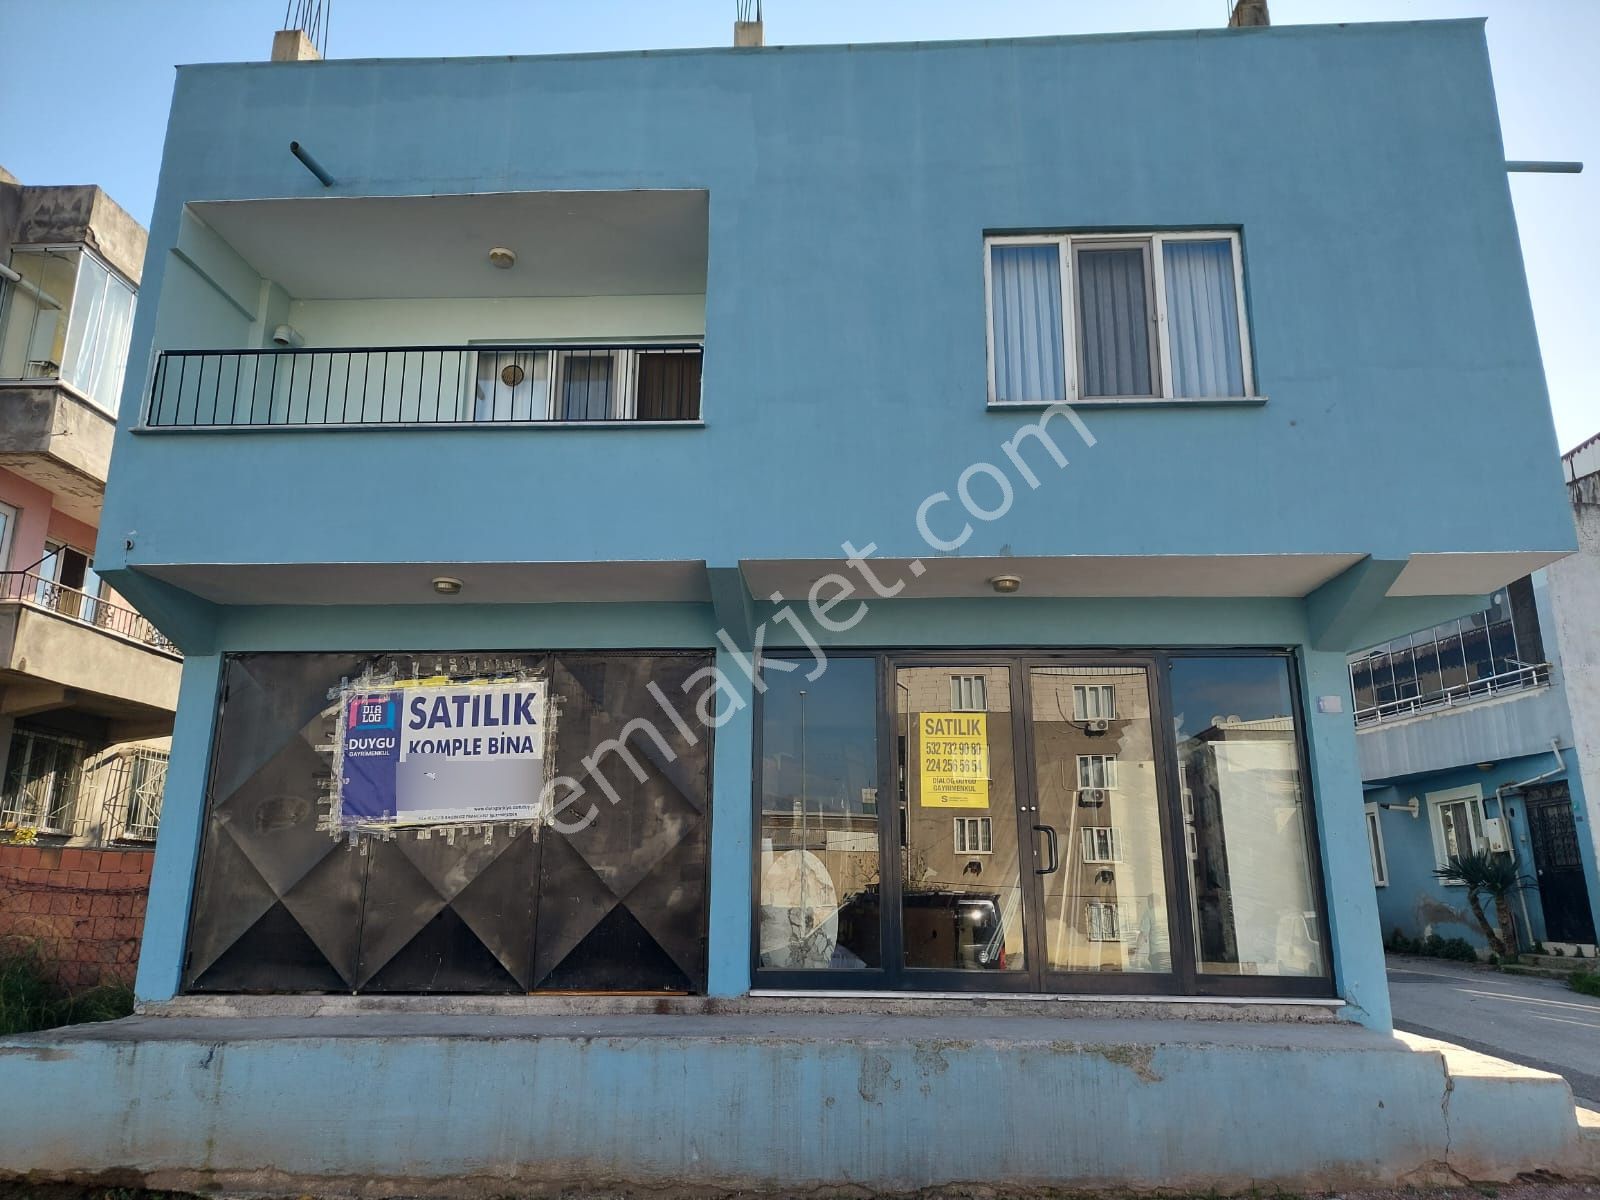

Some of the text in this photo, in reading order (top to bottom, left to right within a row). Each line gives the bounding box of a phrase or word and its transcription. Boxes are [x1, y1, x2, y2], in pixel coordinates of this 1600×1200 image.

[362, 705, 382, 714] DIA
[408, 692, 537, 730] SATILIK
[362, 714, 382, 723] LOG
[925, 718, 982, 736] SATILIK
[349, 737, 396, 750] DUYGU
[409, 732, 534, 757] KOMPLE BİNA
[926, 741, 941, 754] 532
[926, 758, 941, 772] 224
